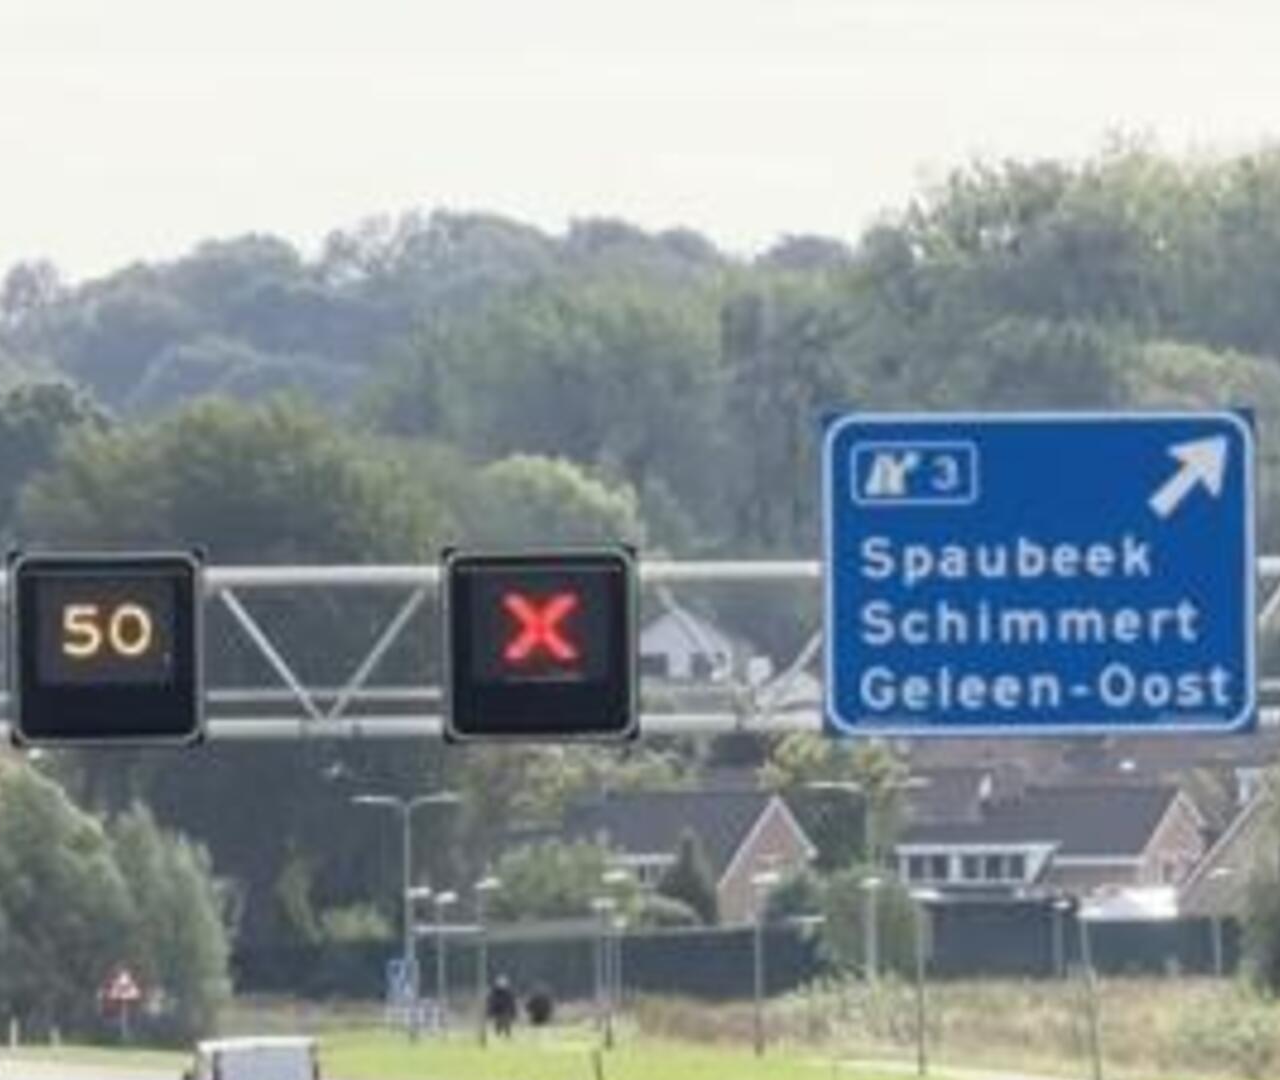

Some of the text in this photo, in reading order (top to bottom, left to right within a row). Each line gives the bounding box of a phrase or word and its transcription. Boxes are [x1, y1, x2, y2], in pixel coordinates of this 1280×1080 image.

[932, 455, 959, 491] 3
[861, 535, 1151, 586] Spaubeek
[62, 604, 152, 657] 50
[861, 599, 1199, 645] Schimmert
[860, 663, 1231, 711] Geleen-Oost
